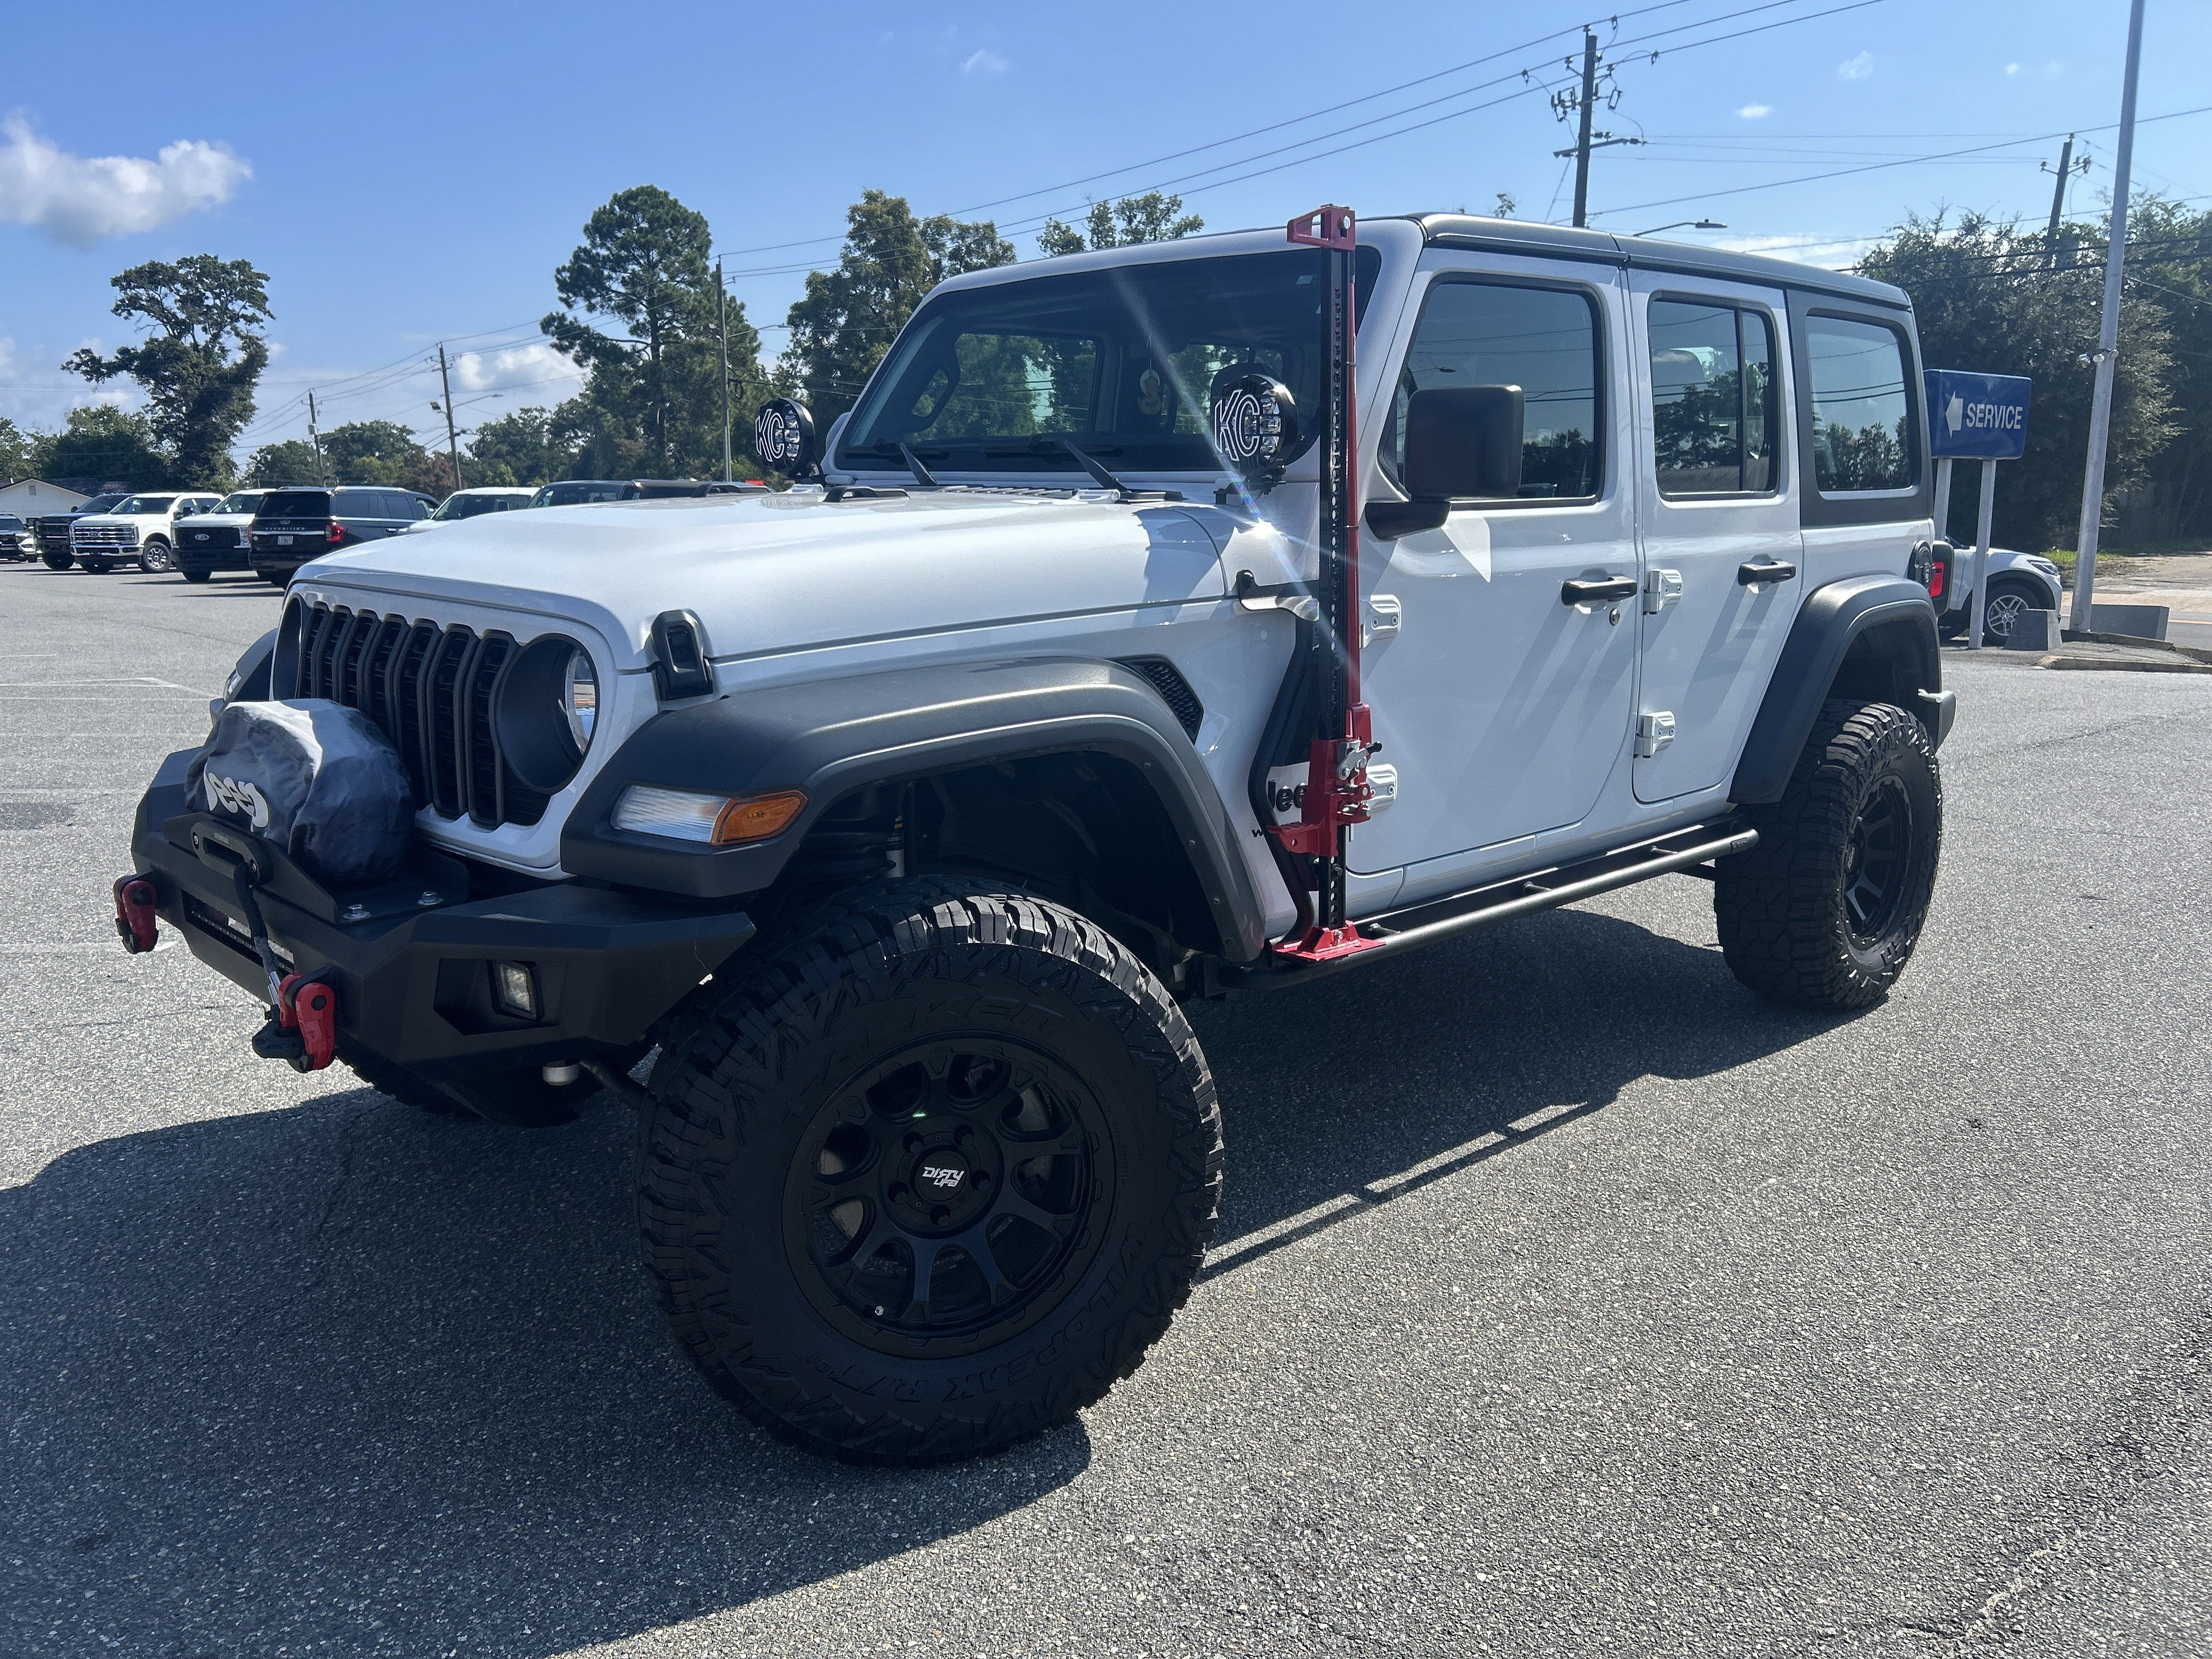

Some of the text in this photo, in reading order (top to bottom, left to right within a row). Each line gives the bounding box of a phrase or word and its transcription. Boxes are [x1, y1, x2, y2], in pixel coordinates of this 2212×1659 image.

[1214, 388, 1260, 462] KC
[1966, 403, 2024, 430] SERVICE
[755, 408, 785, 462] KC
[1268, 780, 1308, 812] Jee
[922, 1166, 965, 1181] DIRTY
